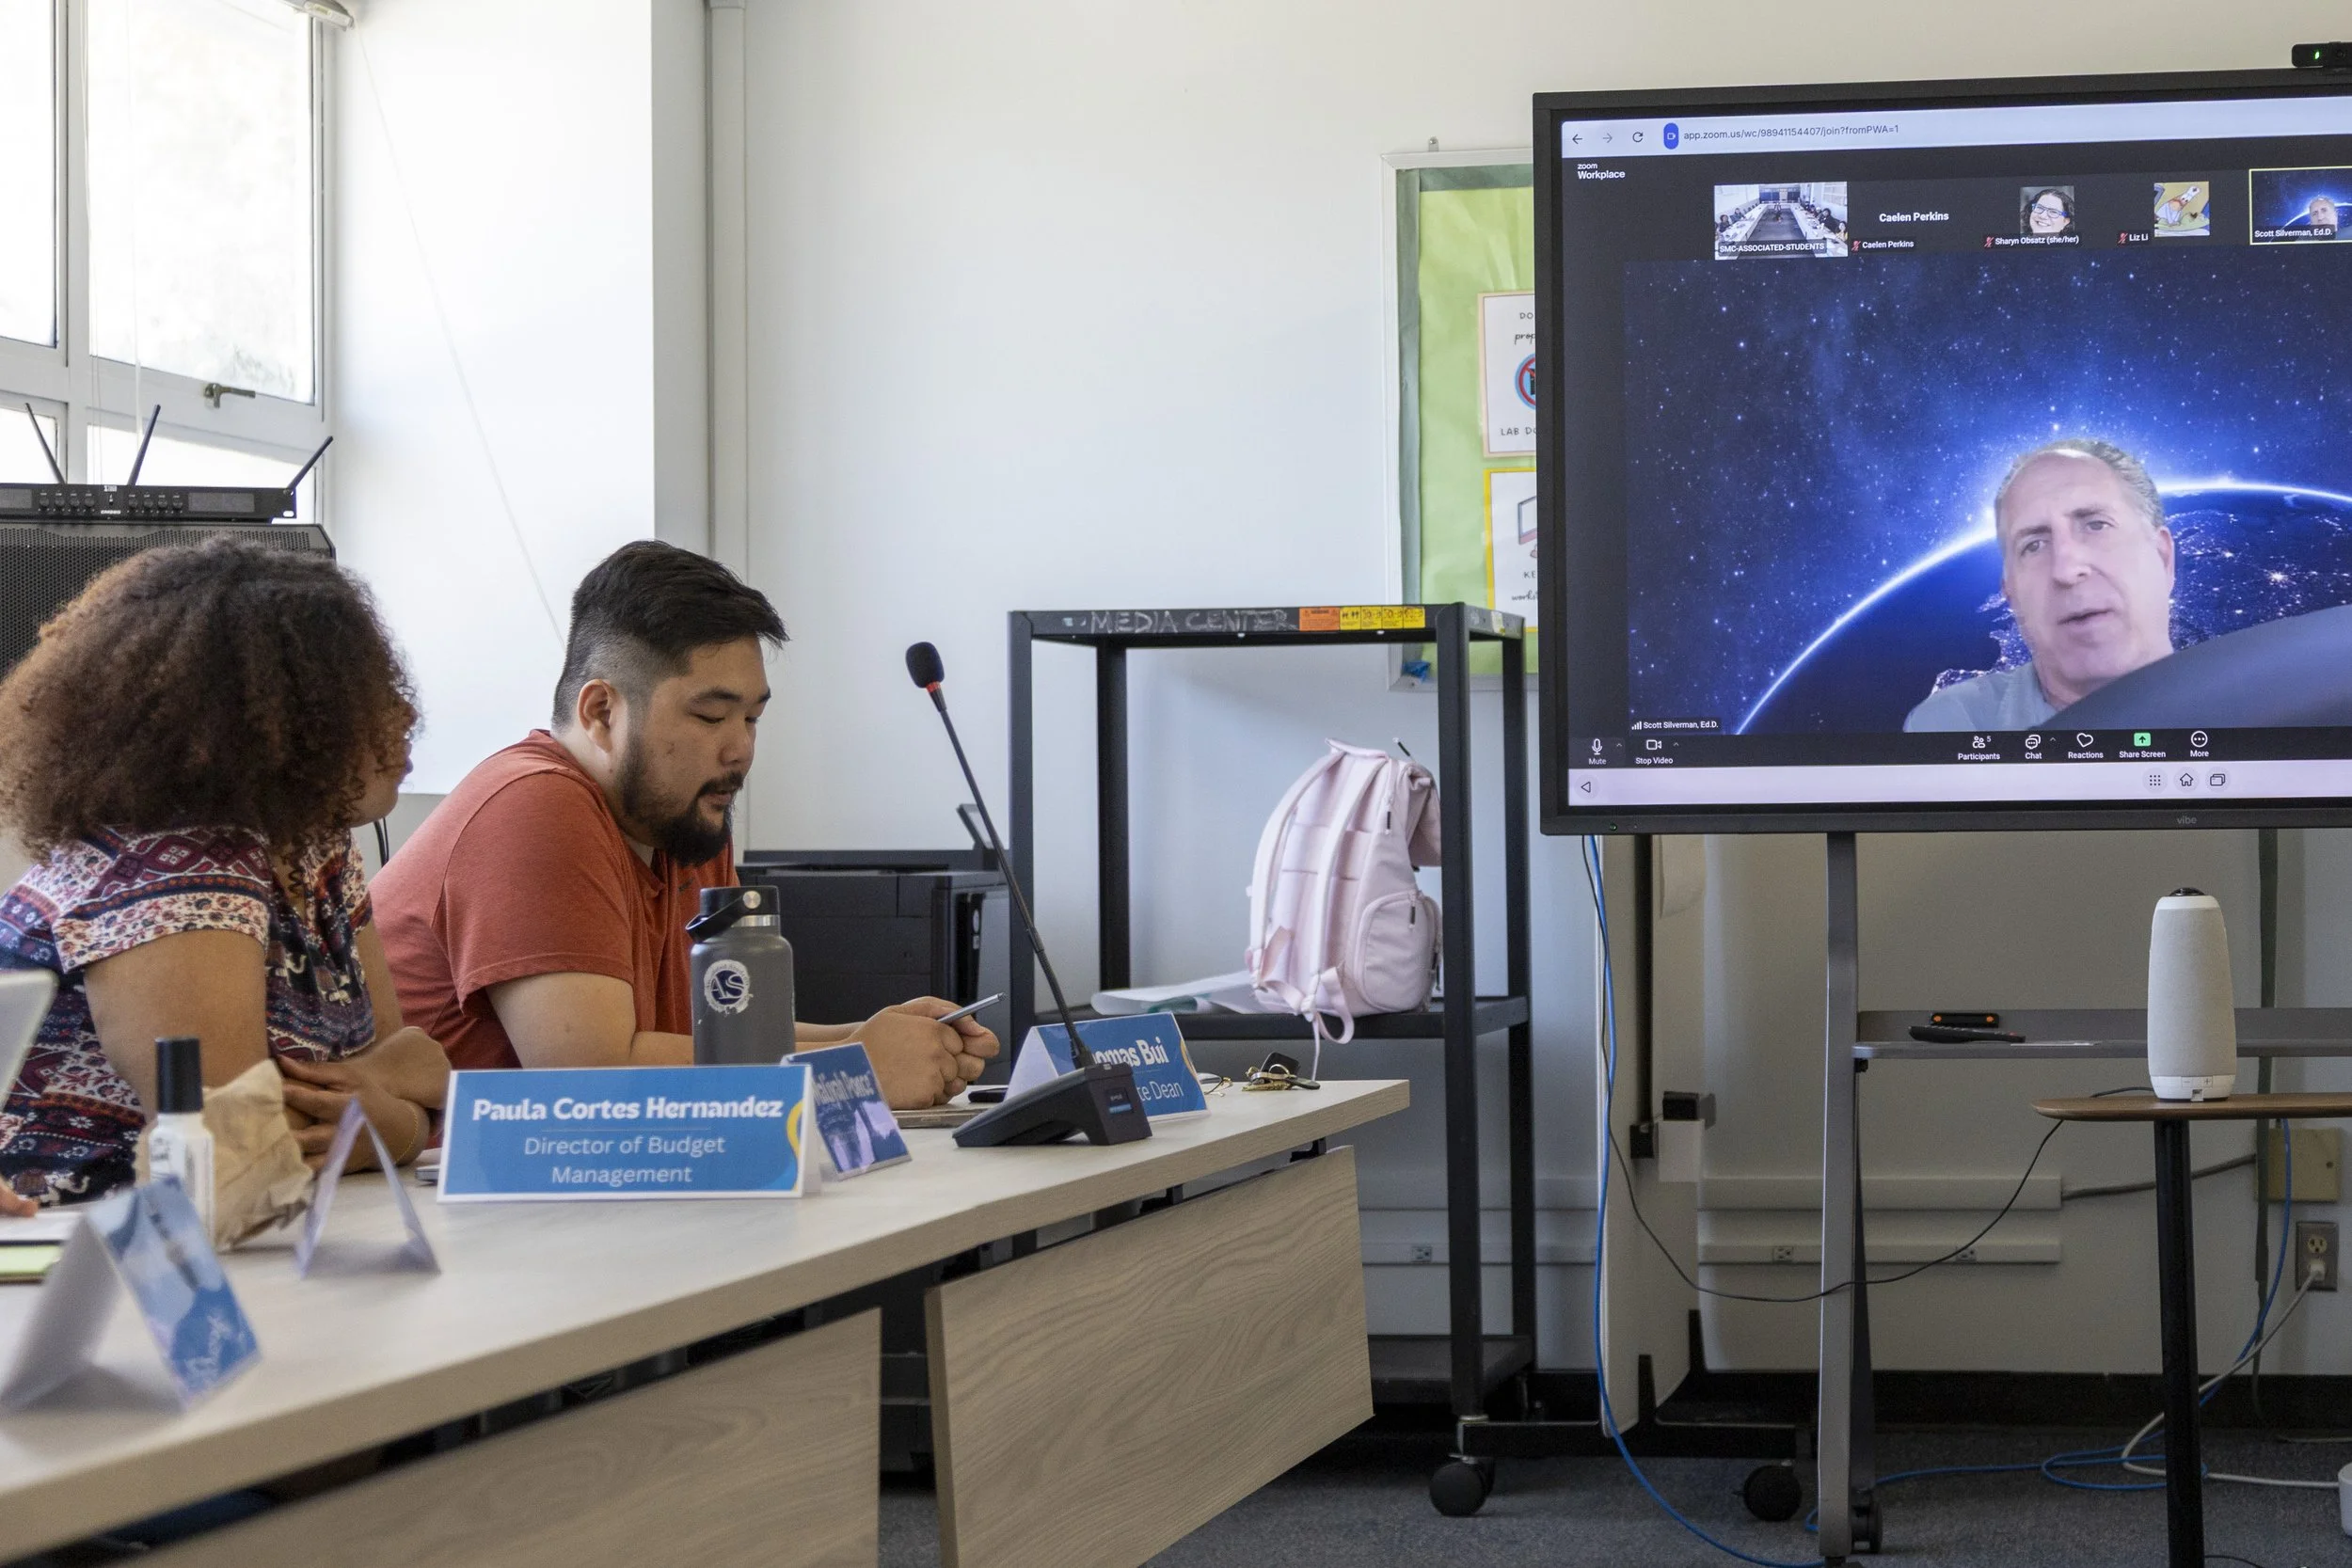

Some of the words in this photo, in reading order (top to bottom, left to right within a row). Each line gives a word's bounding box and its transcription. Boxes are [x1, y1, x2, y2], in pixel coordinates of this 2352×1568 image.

[1577, 170, 1626, 180] Workplace
[1879, 213, 1912, 222] Caelen
[1913, 212, 1949, 221] Perkins
[2254, 230, 2274, 238] Scott
[2275, 229, 2312, 237] Silverman,
[2313, 228, 2333, 236] Ed.D.
[1862, 240, 1886, 248] Caelen
[1887, 240, 1915, 248] Perkins
[1994, 237, 2020, 245] Sharyn
[2020, 236, 2046, 245] Obsatz
[2046, 235, 2079, 245] (she/her)
[1719, 243, 1825, 253] SMC-ASSOCIATED-STUDENTS
[1501, 427, 1519, 436] LAB
[1090, 610, 1179, 634] MEDIA
[1185, 609, 1297, 632] CENTER
[1663, 721, 1699, 729] Silverman,
[1958, 752, 2000, 761] Participants
[2068, 751, 2104, 759] Reactions
[2119, 750, 2140, 758] Share
[2140, 750, 2167, 758] Screen
[1653, 756, 1674, 765] Video
[2176, 816, 2198, 825] vibe
[1136, 1036, 1170, 1066] Bui
[1149, 1080, 1184, 1101] Dean
[472, 1098, 548, 1121] Paula
[553, 1097, 641, 1120] Cortes
[646, 1095, 785, 1119] Hernandez
[524, 1136, 614, 1156] Director
[619, 1134, 641, 1155] of
[648, 1135, 726, 1159] Budget
[551, 1165, 693, 1188] Management
